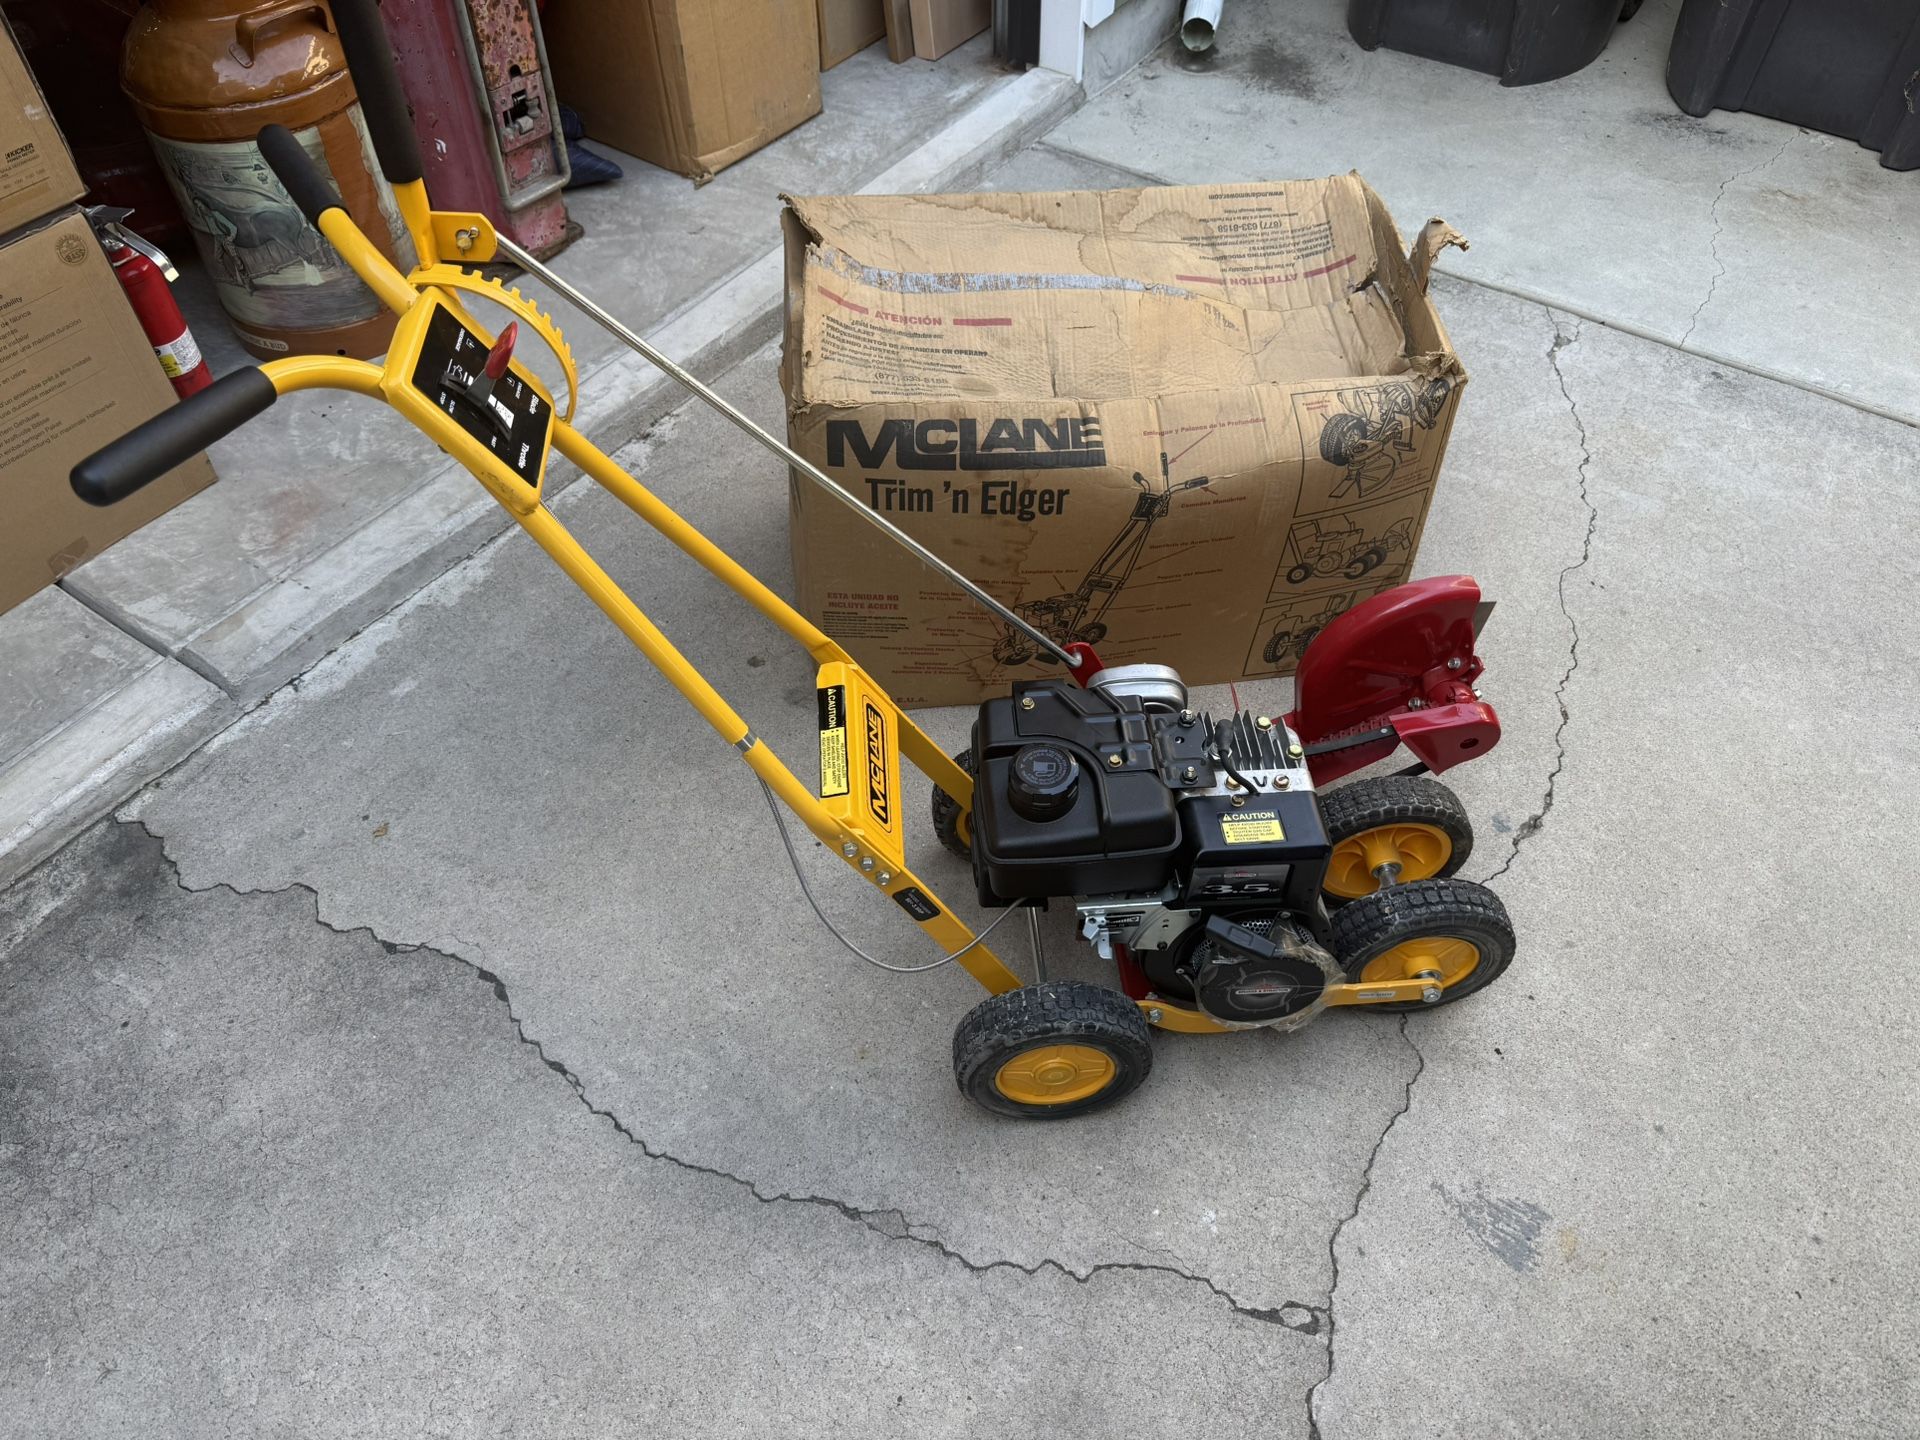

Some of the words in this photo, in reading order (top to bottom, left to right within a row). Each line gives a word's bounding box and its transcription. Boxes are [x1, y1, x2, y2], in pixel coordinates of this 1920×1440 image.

[10, 143, 34, 157] KICKER
[1230, 273, 1298, 286] ATTENTION
[875, 310, 943, 326] ATENCIÓN
[529, 394, 539, 415] Blade
[518, 442, 529, 469] Throttle
[865, 478, 934, 512] Trim
[980, 481, 1070, 522] Edger
[829, 601, 865, 609] INCLUYE
[828, 696, 837, 728] CAUTION
[868, 708, 887, 820] MCLANE
[1232, 812, 1275, 820] CAUTION
[1202, 883, 1269, 894] 3.5
